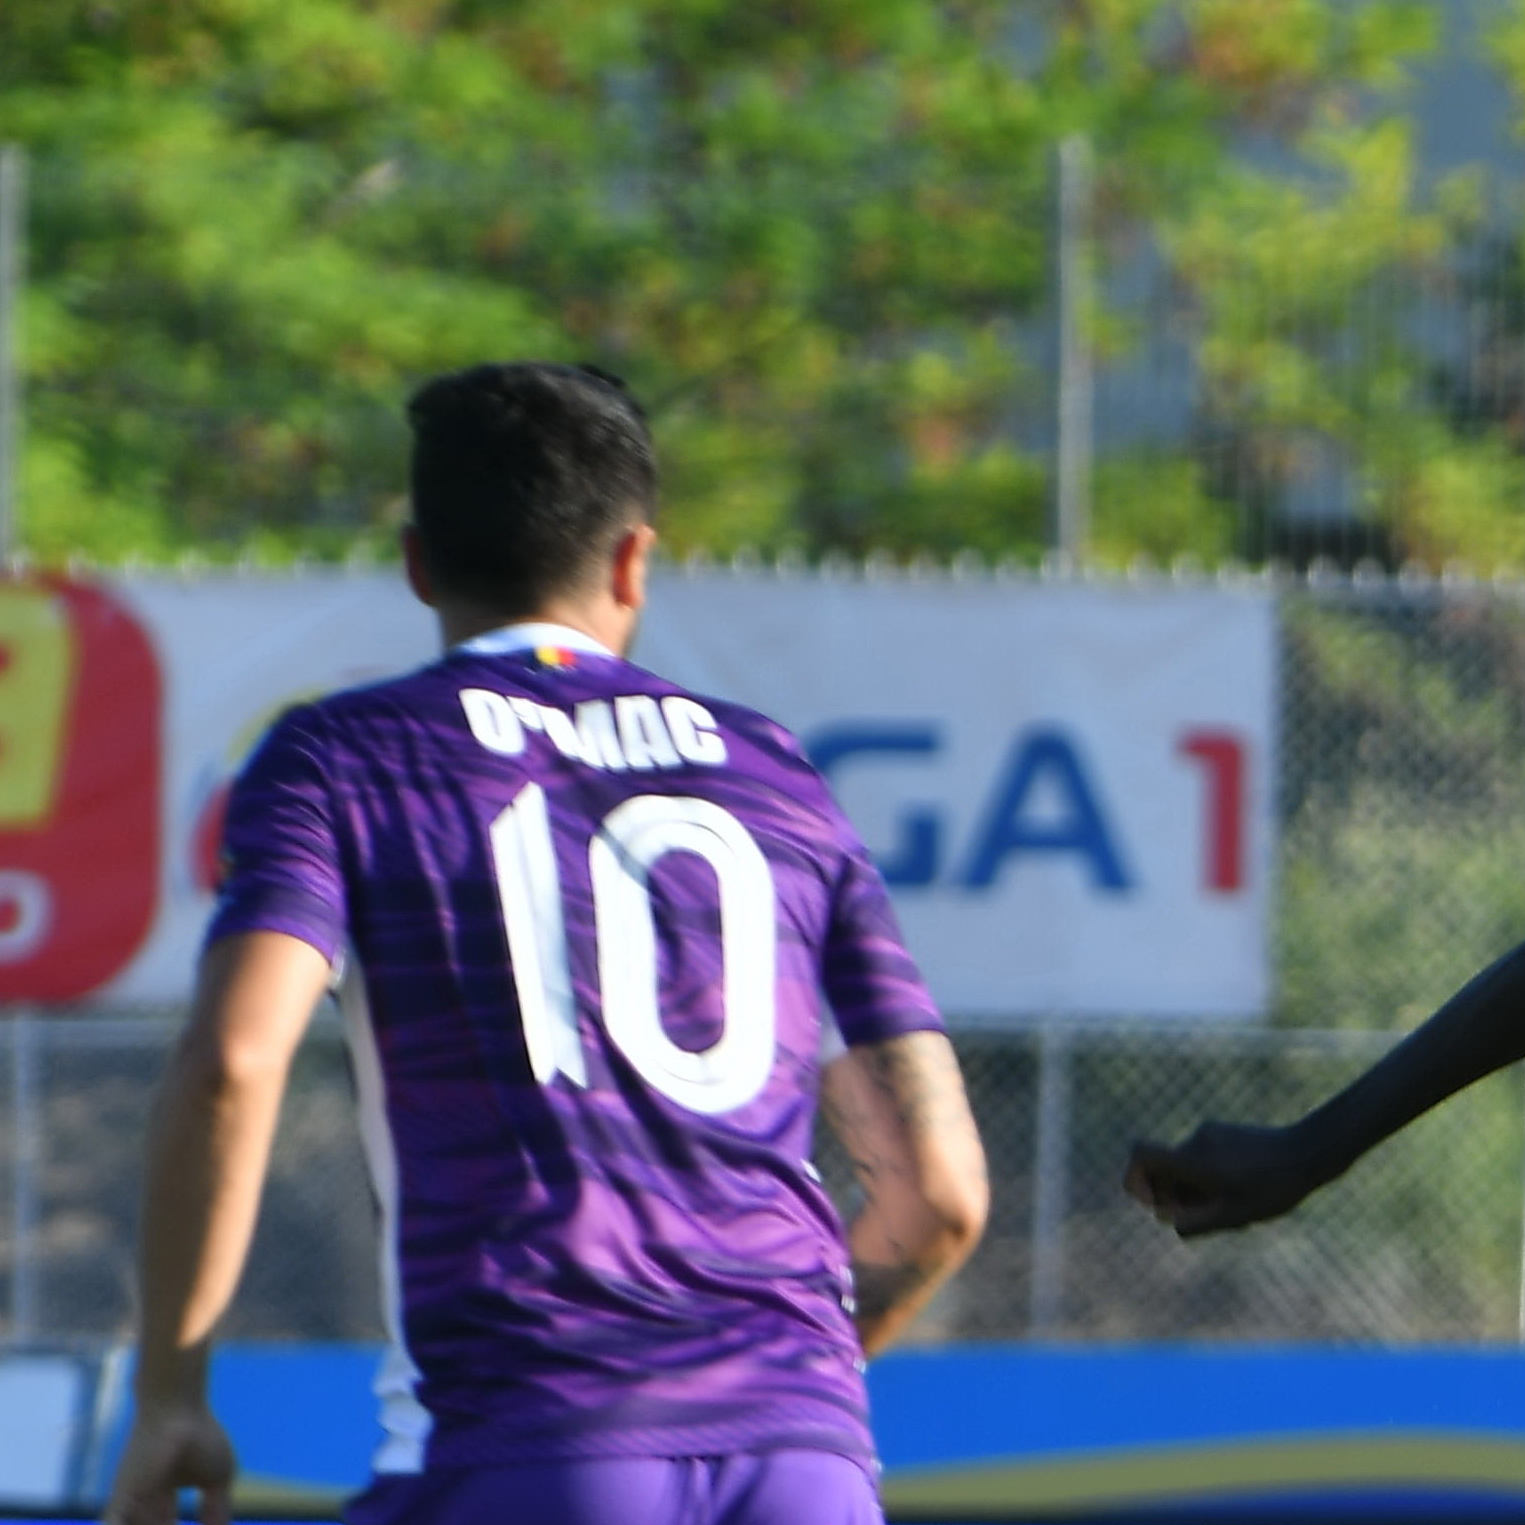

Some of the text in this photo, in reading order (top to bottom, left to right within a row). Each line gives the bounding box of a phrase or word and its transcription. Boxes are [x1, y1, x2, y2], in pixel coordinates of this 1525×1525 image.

[805, 723, 1246, 893] GA 1
[490, 781, 776, 1114] 10
